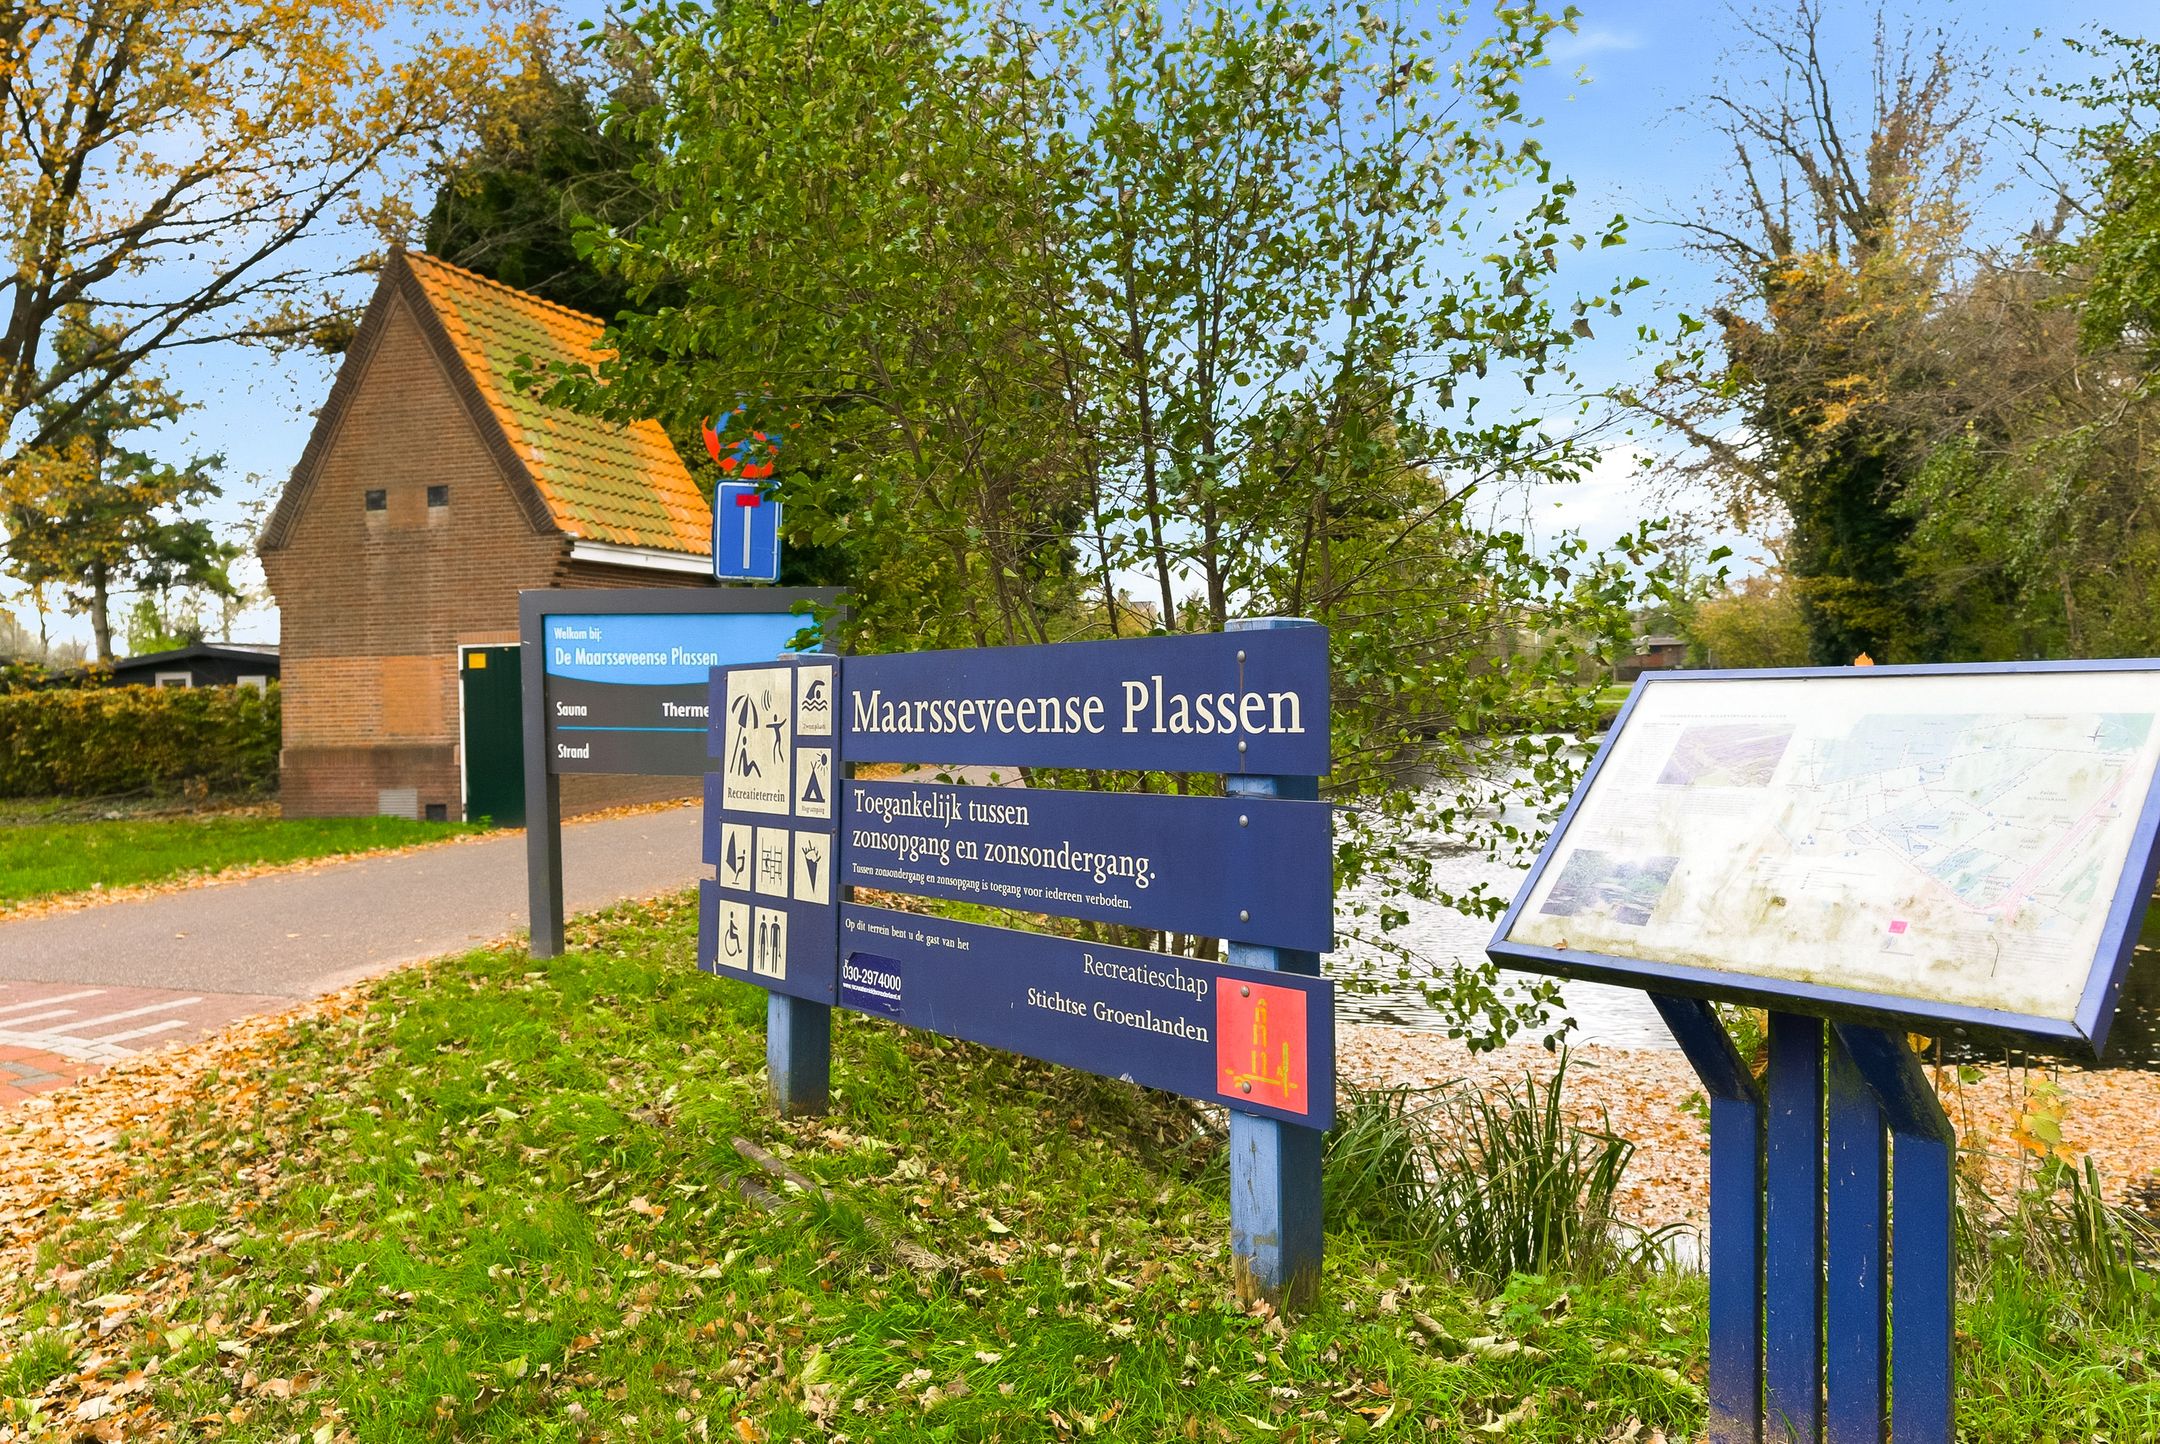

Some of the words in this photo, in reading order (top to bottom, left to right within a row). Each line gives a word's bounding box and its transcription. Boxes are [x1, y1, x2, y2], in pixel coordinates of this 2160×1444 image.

[554, 626, 587, 640] Welkom
[589, 625, 602, 642] bij:
[555, 647, 572, 665] De
[575, 647, 667, 666] Maarsseveense
[671, 645, 718, 666] Plassen
[556, 701, 587, 717] Sauna
[852, 689, 1105, 734] Maarsseveense
[1121, 675, 1306, 734] Plassen
[557, 743, 590, 759] Strand
[727, 787, 785, 803] Recreatieterrein
[854, 788, 963, 829] Toegankelijk
[968, 800, 1030, 826] tussen
[852, 830, 951, 866] zonsopgang
[955, 839, 979, 860] en
[984, 841, 1156, 889] zonsondergang.
[852, 863, 874, 875] Tussen
[875, 868, 925, 885] zonsondergang
[926, 873, 936, 883] en
[937, 876, 980, 893] zonsopgang
[981, 879, 989, 891] is
[990, 881, 1021, 899] toegang
[1023, 887, 1043, 898] voor
[1045, 887, 1082, 903] iedereen
[1084, 893, 1132, 910] verboden.
[845, 918, 856, 932] Op
[856, 920, 866, 932] dit
[867, 924, 890, 936] terrein
[891, 925, 907, 939] bent
[908, 931, 914, 940] u
[915, 930, 924, 942] de
[926, 935, 940, 947] gast
[942, 937, 955, 949] van
[957, 937, 970, 951] het
[842, 964, 902, 992] 030-2974000
[1083, 953, 1208, 1002] Recreatieschap
[1027, 987, 1088, 1017] Stichtse
[1093, 1001, 1210, 1043] Groenlanden
